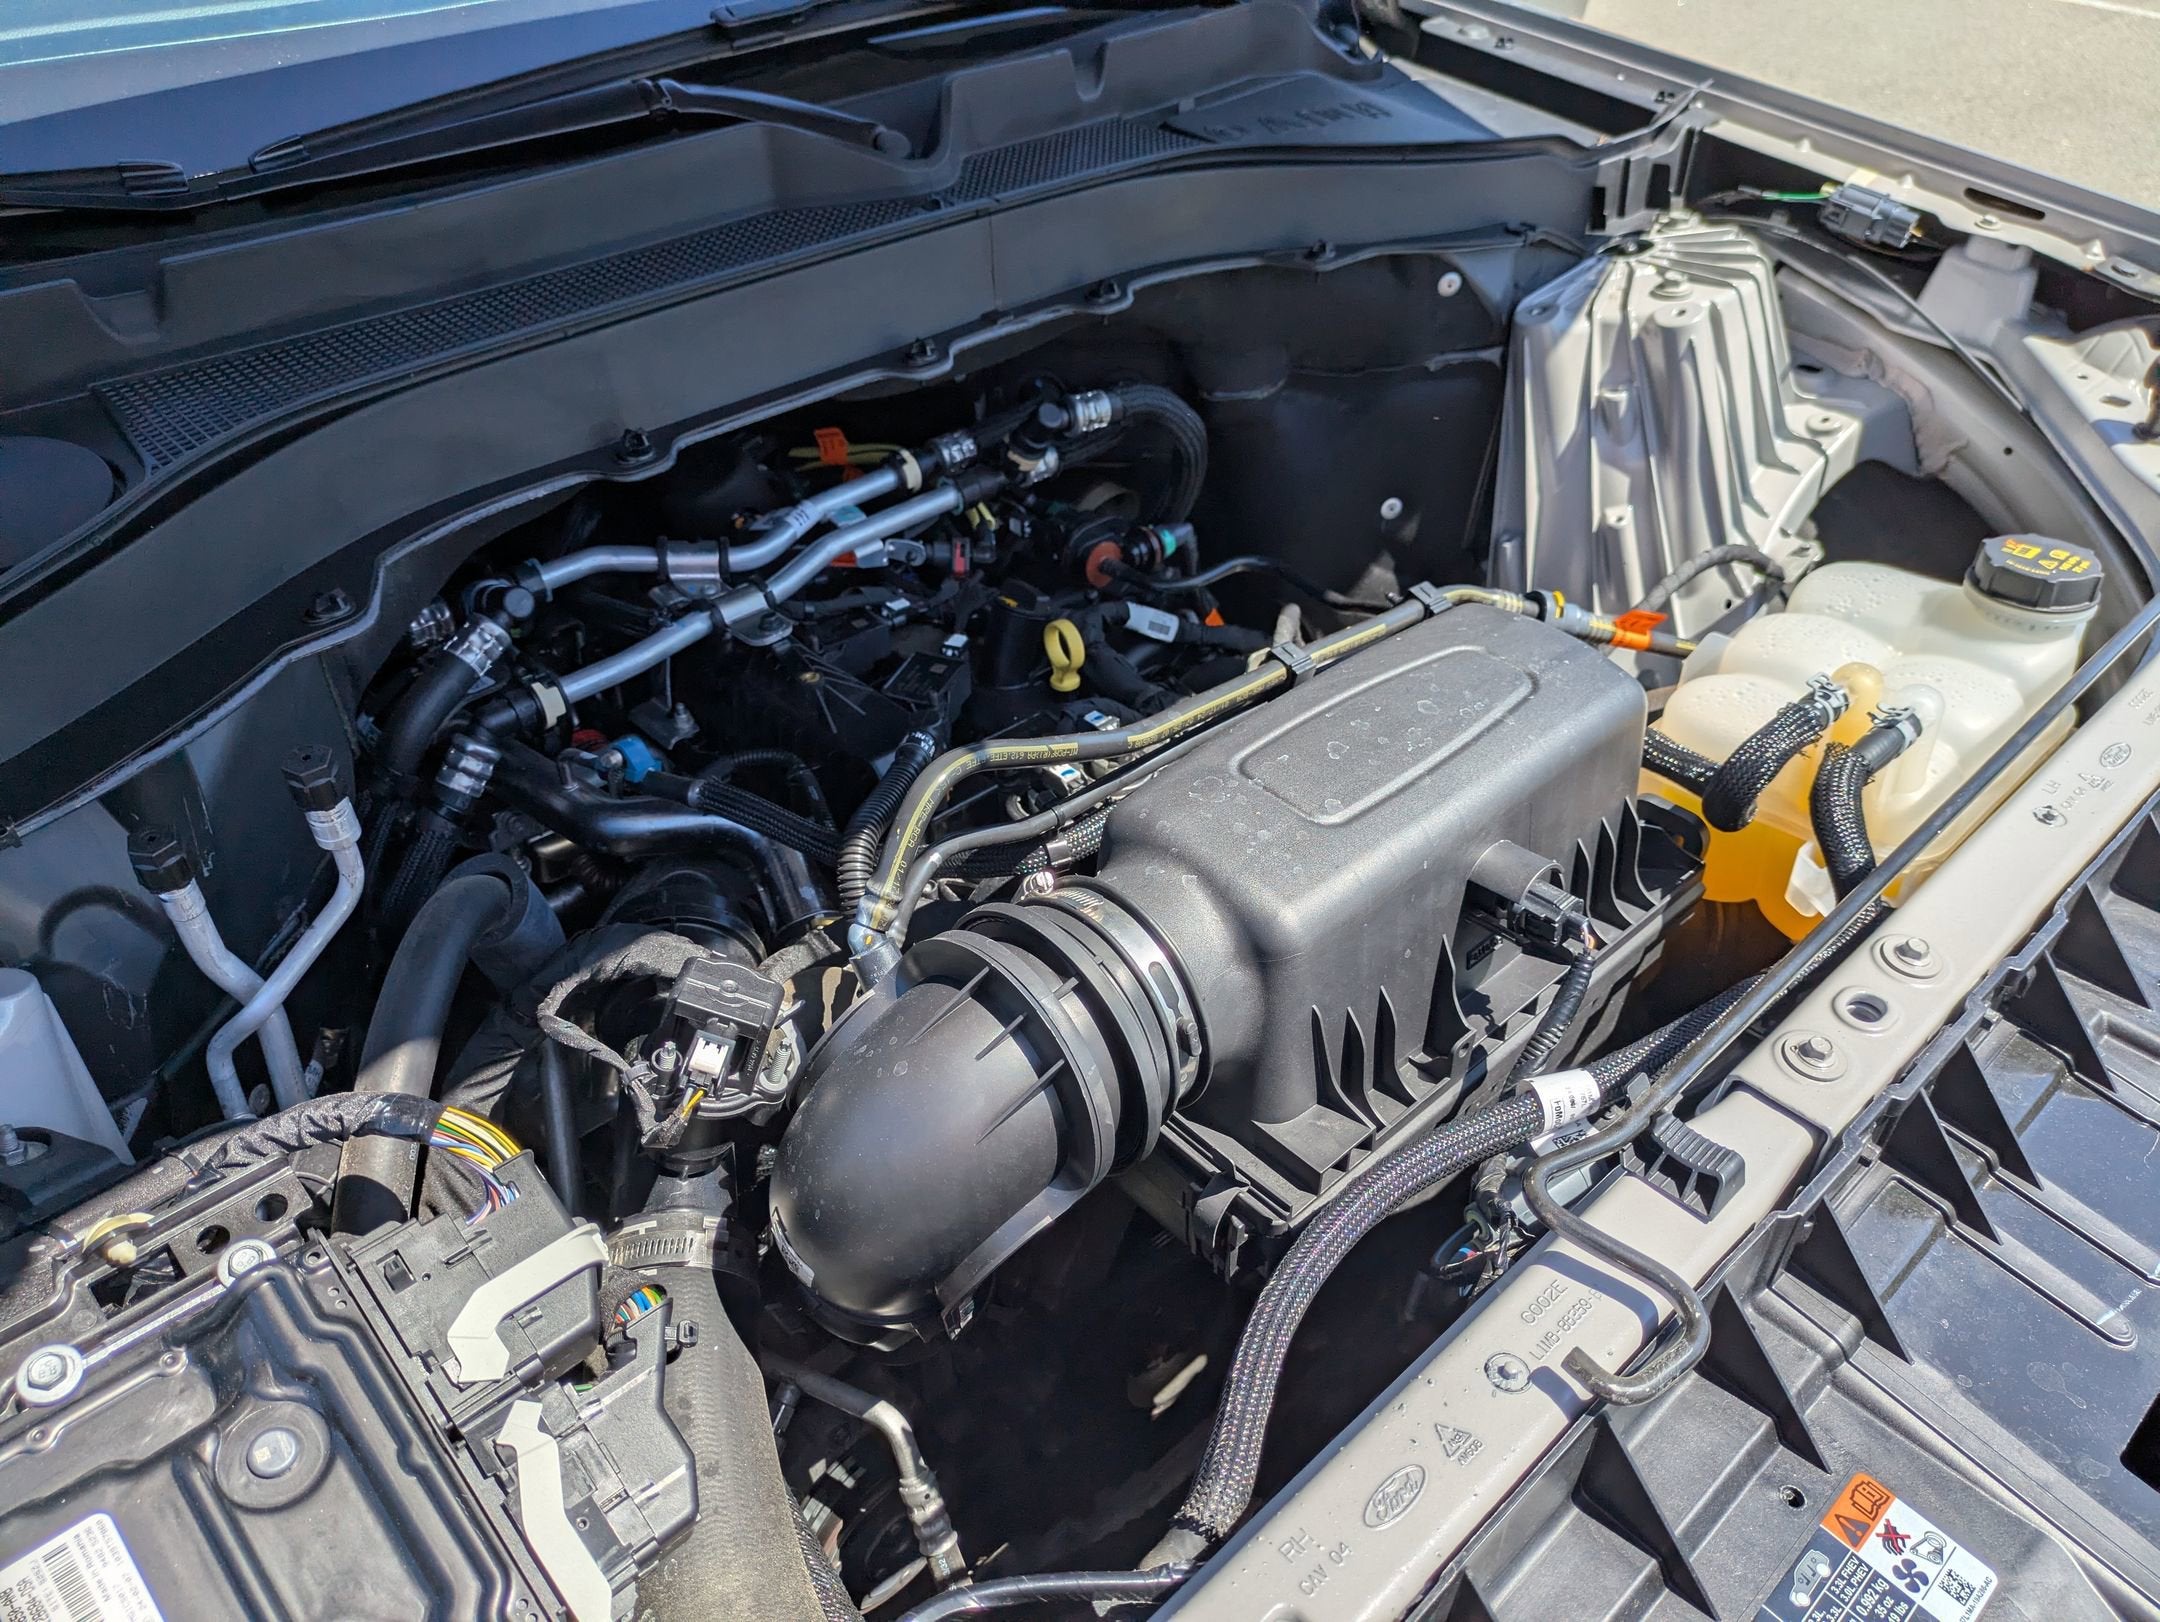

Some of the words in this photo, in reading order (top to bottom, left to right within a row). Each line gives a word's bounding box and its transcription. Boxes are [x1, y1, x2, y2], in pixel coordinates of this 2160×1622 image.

[1279, 1527, 1316, 1563] RH
[1328, 1541, 1352, 1566] 04
[1831, 1577, 1847, 1595] 3.3L
[1841, 1555, 1860, 1579] FHEV
[1840, 1585, 1856, 1602] 3.0L
[1850, 1562, 1869, 1587] PHEV
[1855, 1588, 1880, 1617] 0.992
[1871, 1578, 1890, 1593] kg
[1875, 1602, 1888, 1618] 35
[1882, 1595, 1895, 1607] oz
[1893, 1601, 1909, 1617] lbs
